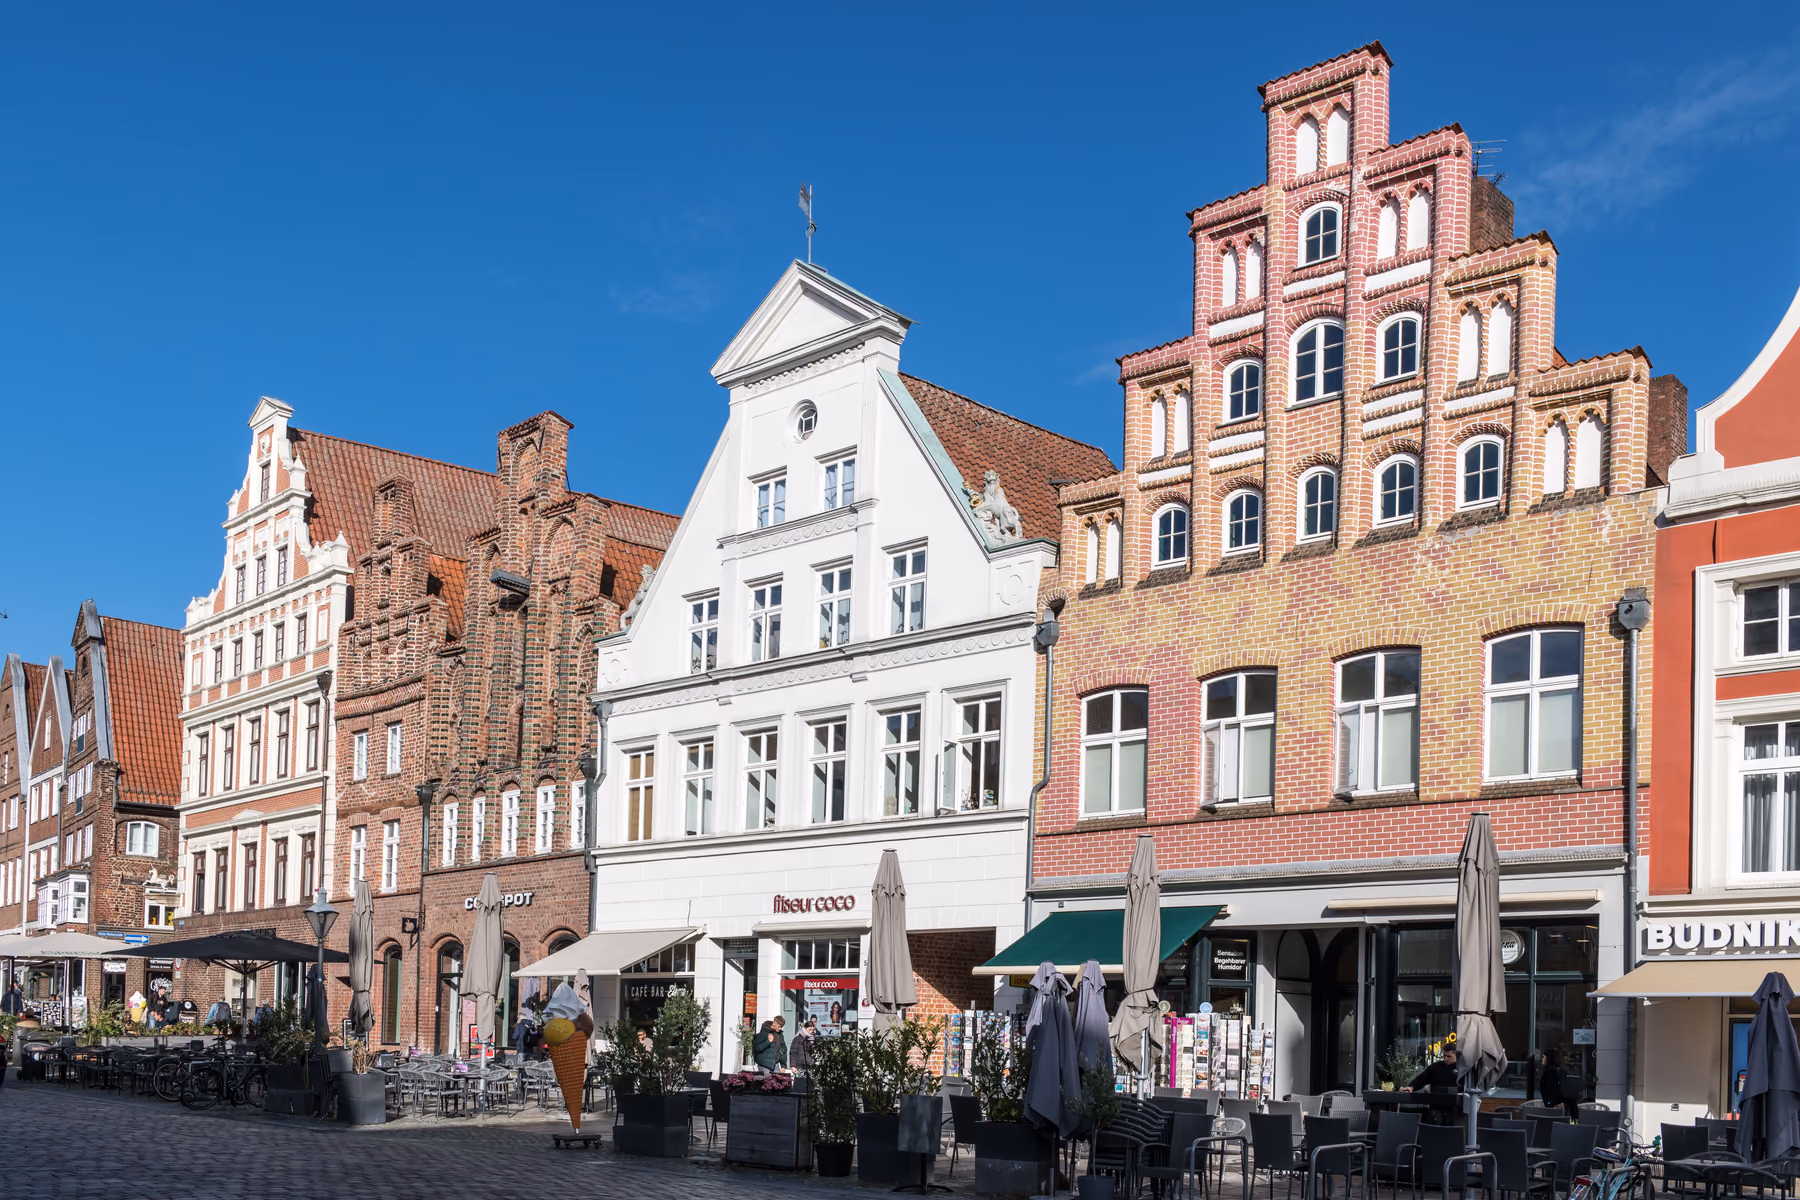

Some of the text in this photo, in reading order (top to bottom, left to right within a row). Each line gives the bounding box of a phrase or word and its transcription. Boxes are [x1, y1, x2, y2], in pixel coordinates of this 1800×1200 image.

[464, 892, 535, 910] CPOT
[1647, 920, 1800, 950] BUDNIK
[631, 984, 648, 997] CAFÉ
